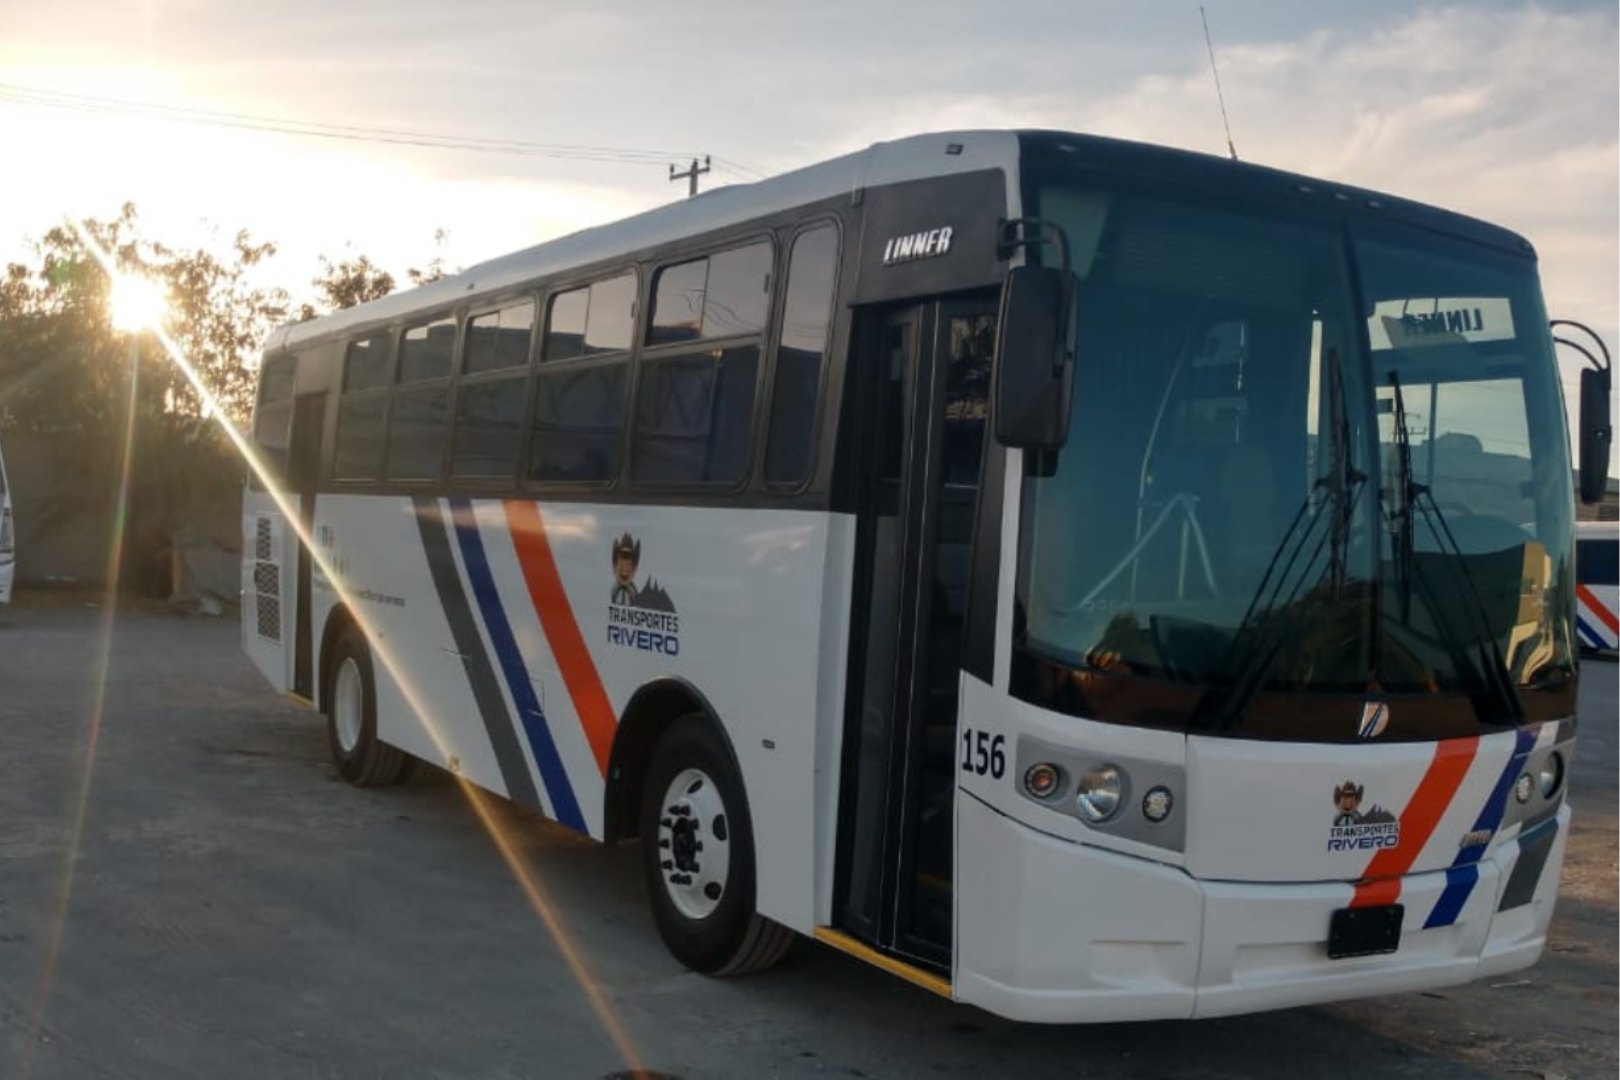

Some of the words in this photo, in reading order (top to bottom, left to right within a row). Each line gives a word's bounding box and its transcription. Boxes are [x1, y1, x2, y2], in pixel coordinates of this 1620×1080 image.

[883, 225, 953, 264] LINNER
[608, 606, 679, 633] TRANSPORTES
[607, 625, 680, 656] RIVERO
[962, 728, 1005, 780] 156
[1328, 835, 1398, 852] RIVERO
